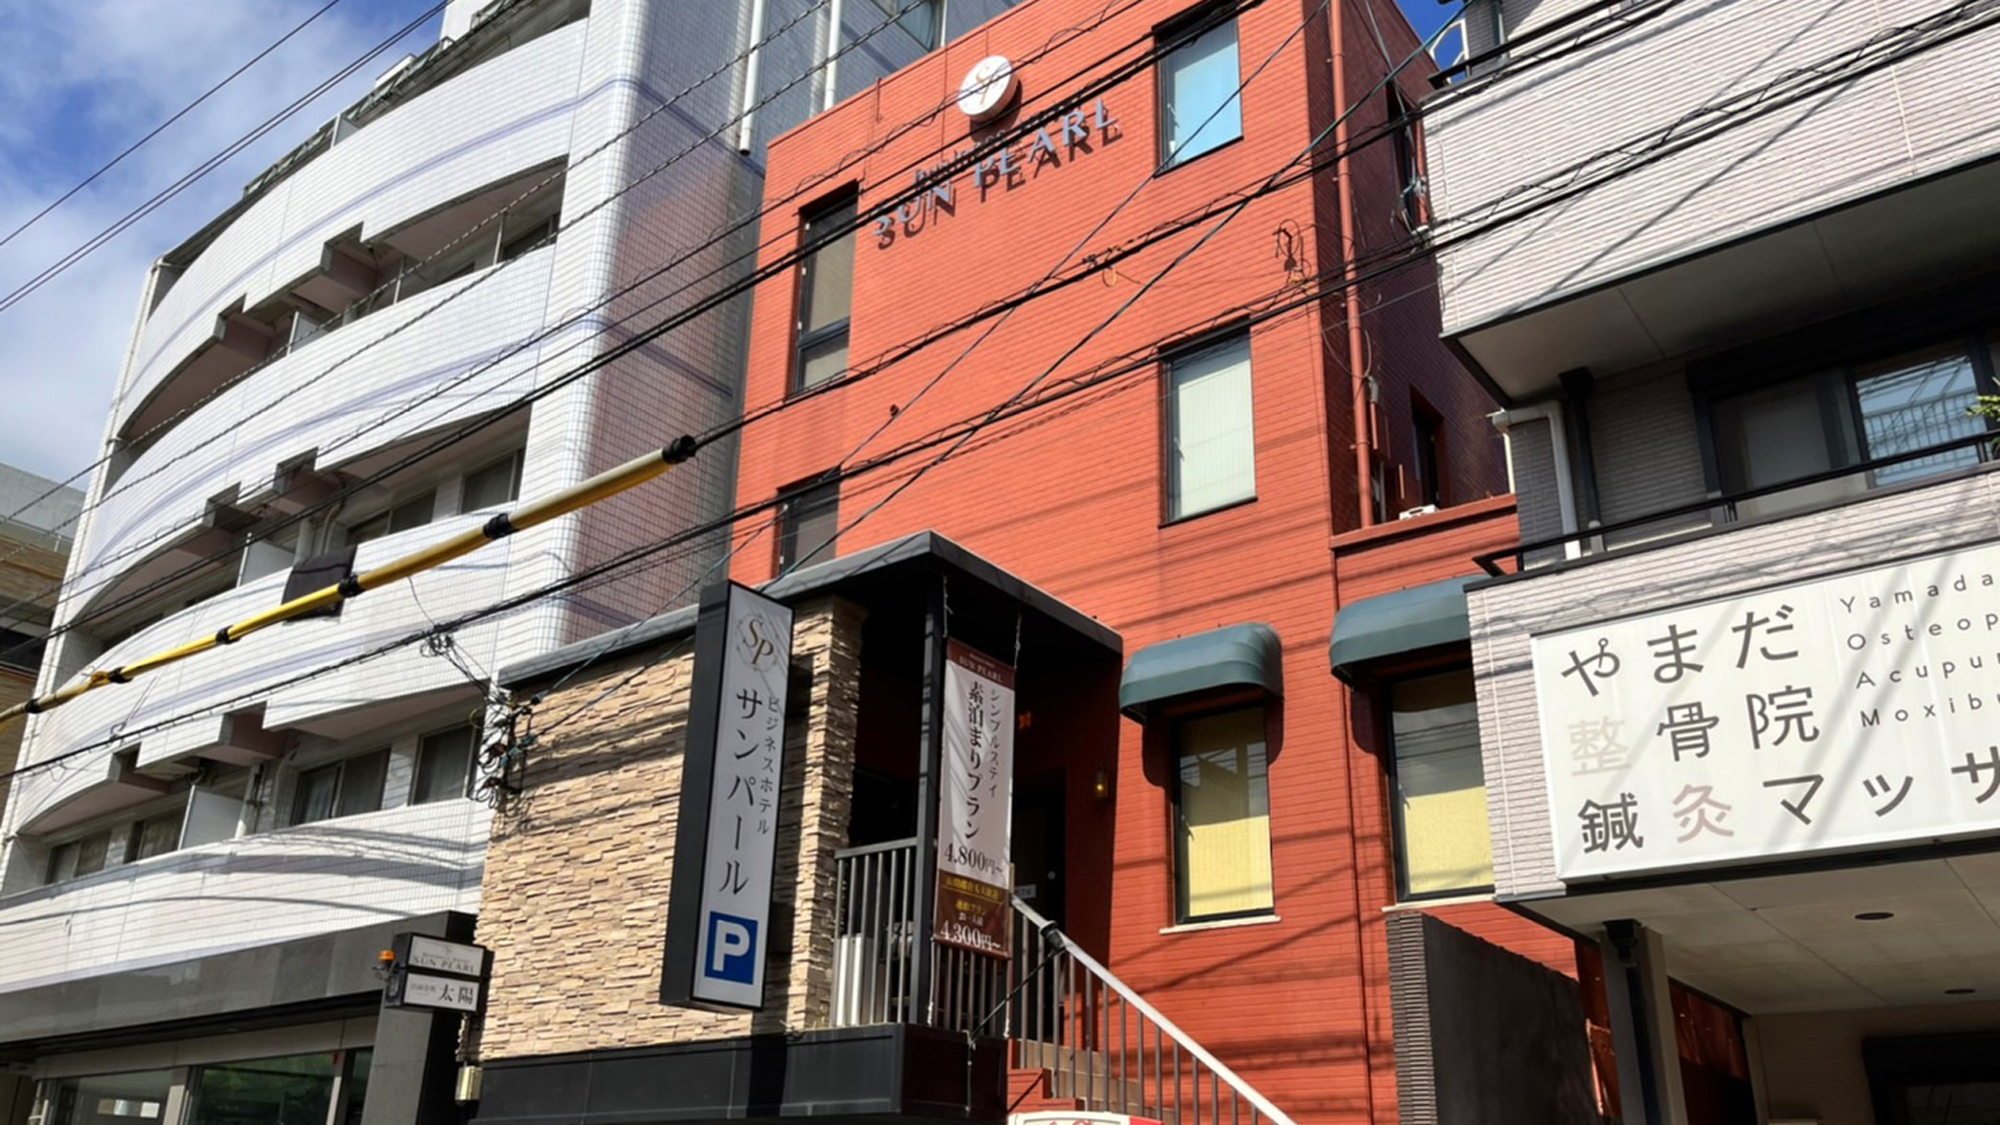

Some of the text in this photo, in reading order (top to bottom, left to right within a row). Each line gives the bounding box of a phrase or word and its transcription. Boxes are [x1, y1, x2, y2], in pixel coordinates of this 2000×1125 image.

[974, 98, 1118, 187] PEARL
[1840, 573, 1994, 614] Yamada
[1561, 604, 1800, 697] やまだ
[1847, 613, 1998, 650] Osteop
[1856, 652, 2000, 689] Acupu
[1567, 685, 1820, 777] 整骨院
[1860, 692, 2000, 728] Moxib
[719, 688, 763, 896] サンパール
[757, 696, 780, 835] ビジネスホテル
[713, 919, 751, 972] P
[438, 983, 475, 1005] 太陽
